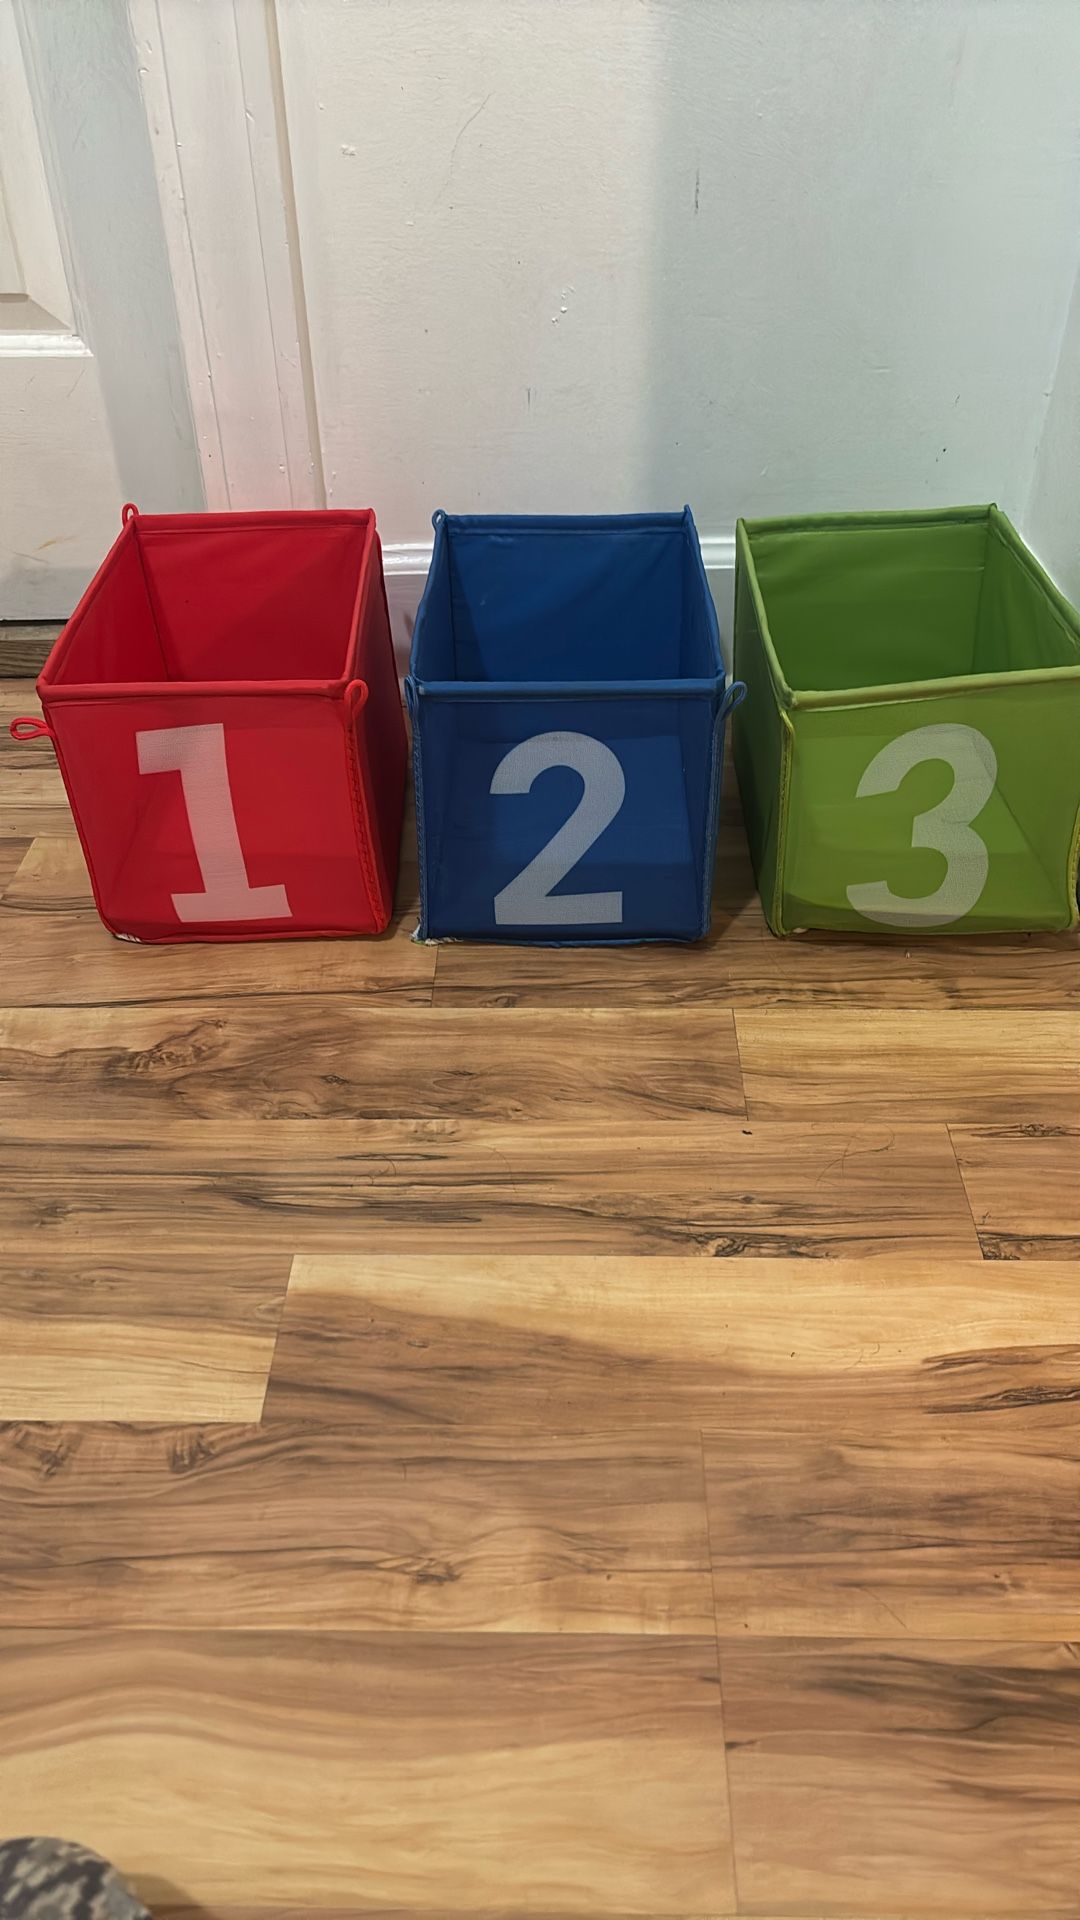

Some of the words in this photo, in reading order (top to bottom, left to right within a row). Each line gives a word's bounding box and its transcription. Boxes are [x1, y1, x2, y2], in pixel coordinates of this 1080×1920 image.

[136, 723, 292, 923] 1
[490, 731, 626, 925] 2
[846, 723, 998, 927] 3
